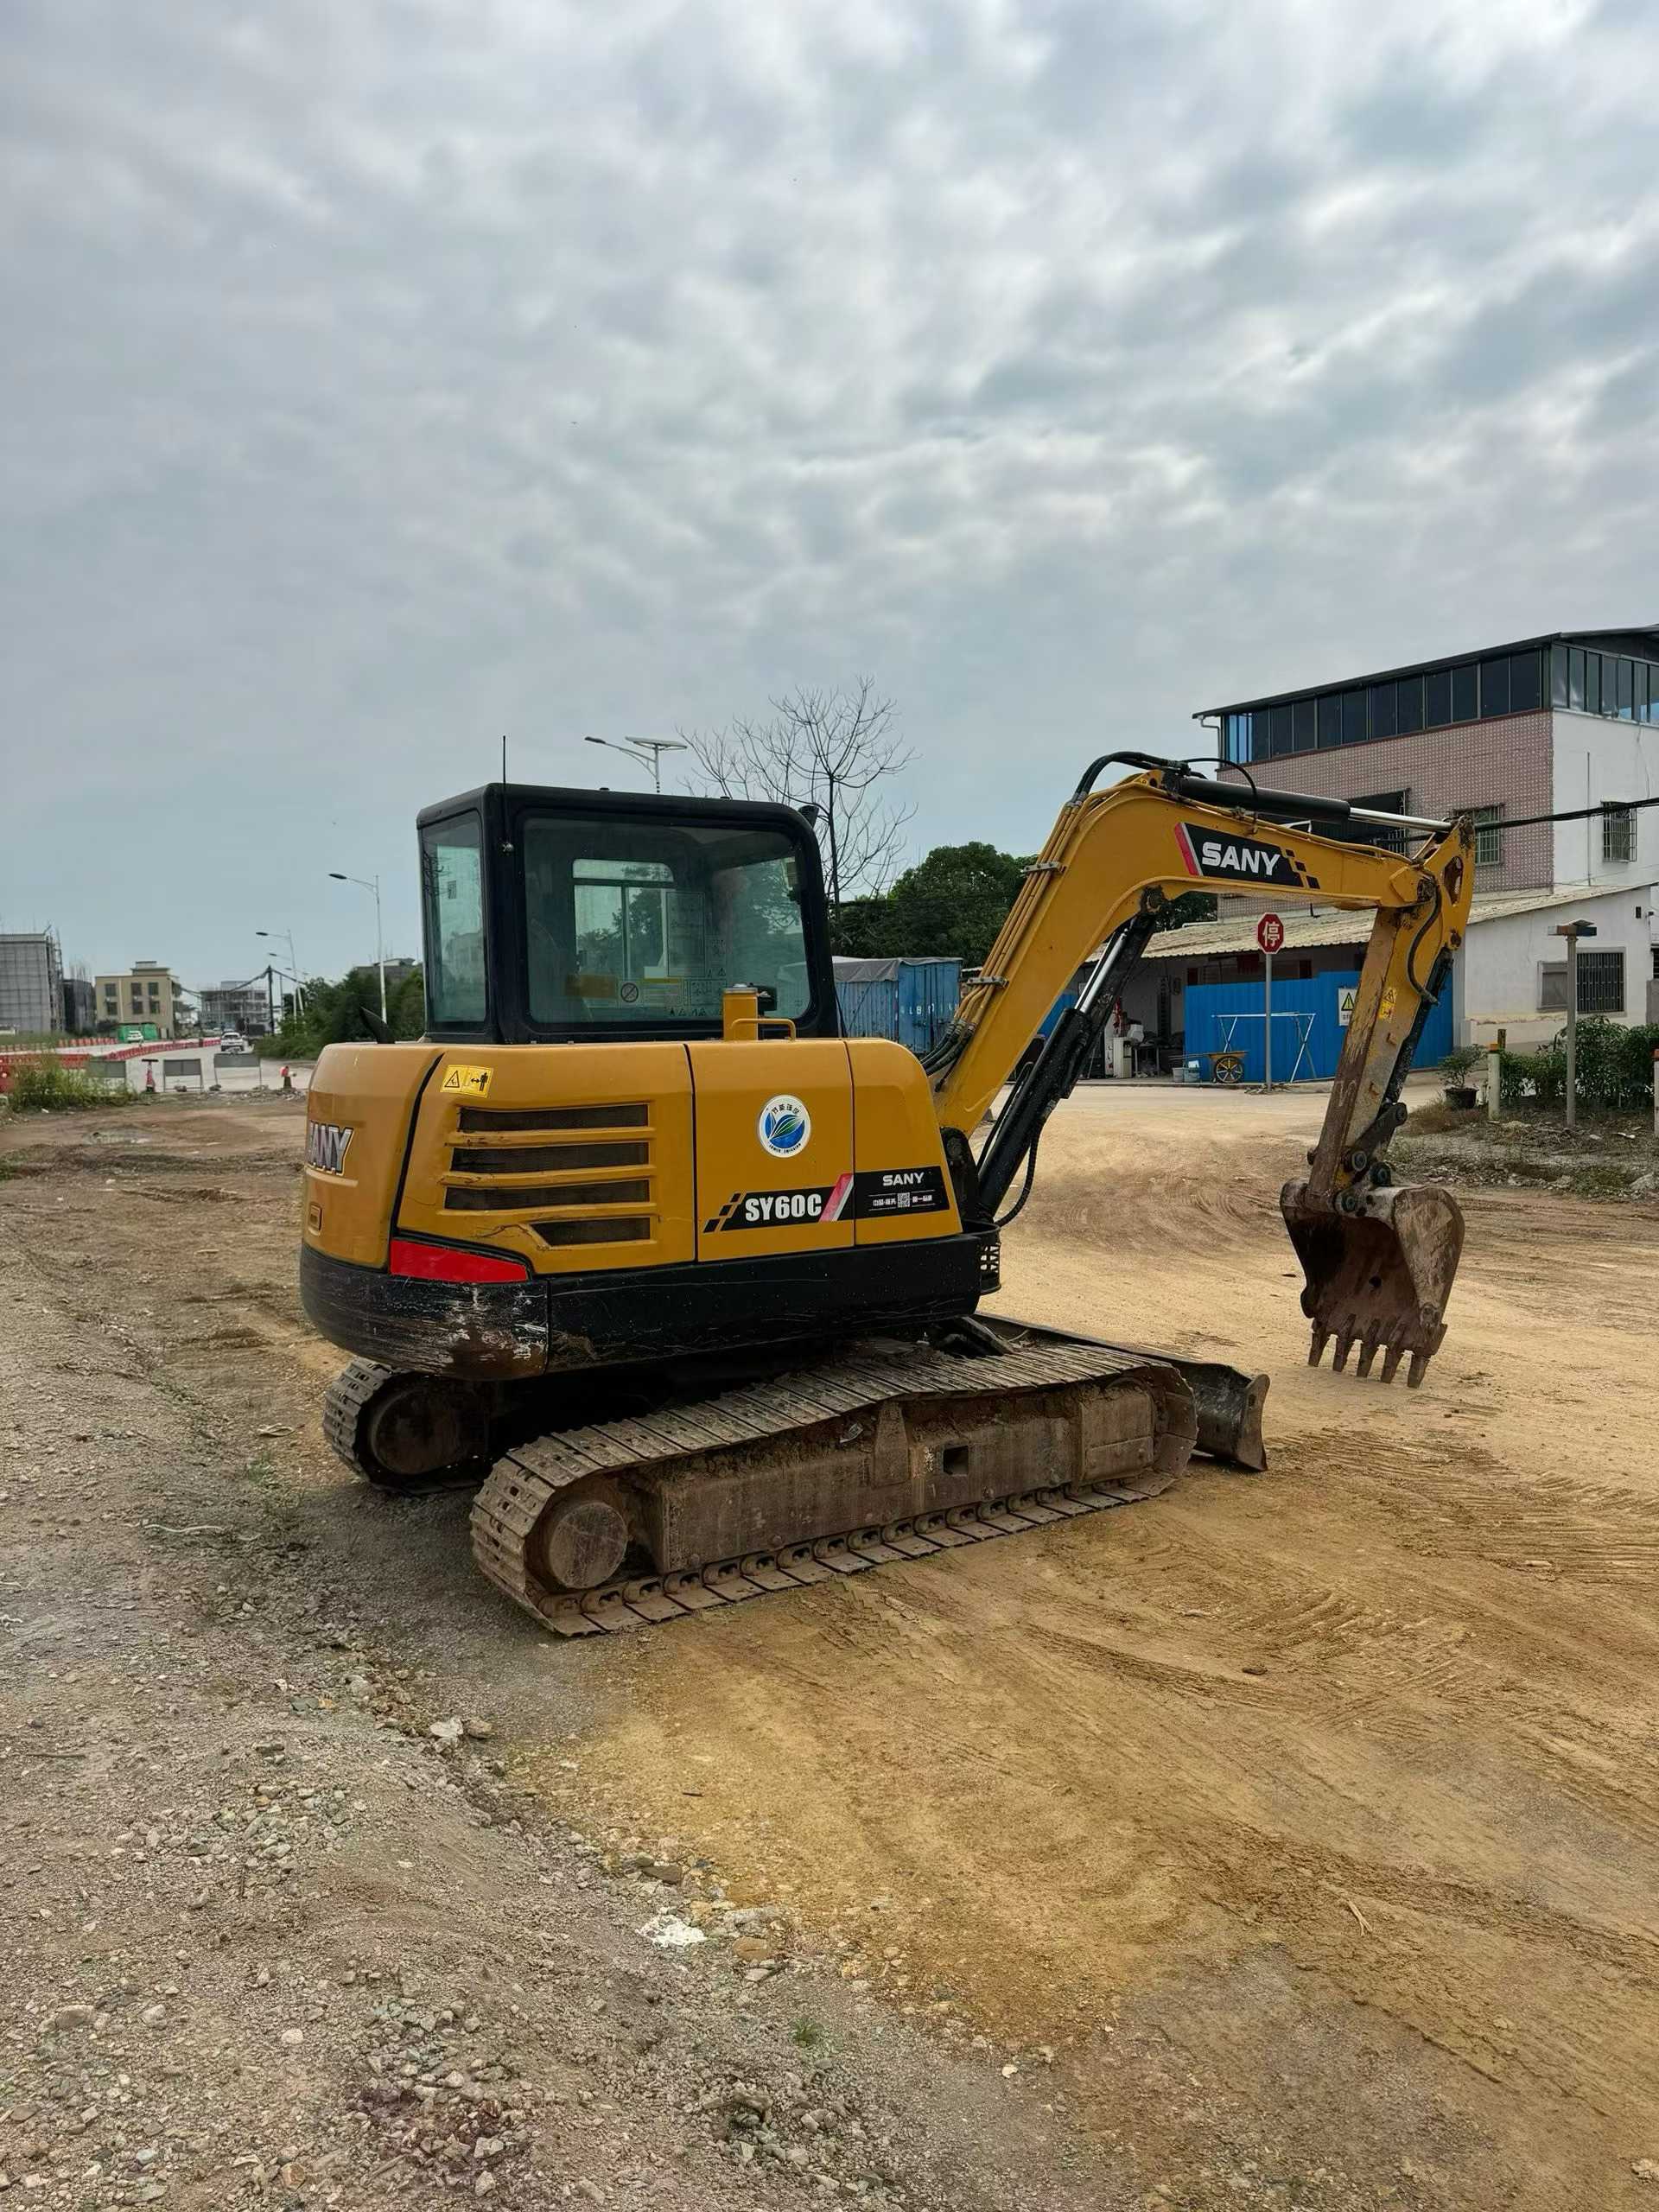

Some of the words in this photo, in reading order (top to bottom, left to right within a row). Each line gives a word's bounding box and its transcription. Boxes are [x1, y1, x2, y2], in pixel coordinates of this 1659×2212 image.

[1202, 842, 1281, 875] SANY
[1262, 921, 1280, 947] 停
[882, 1172, 925, 1186] SANY
[745, 1193, 822, 1222] SY60C
